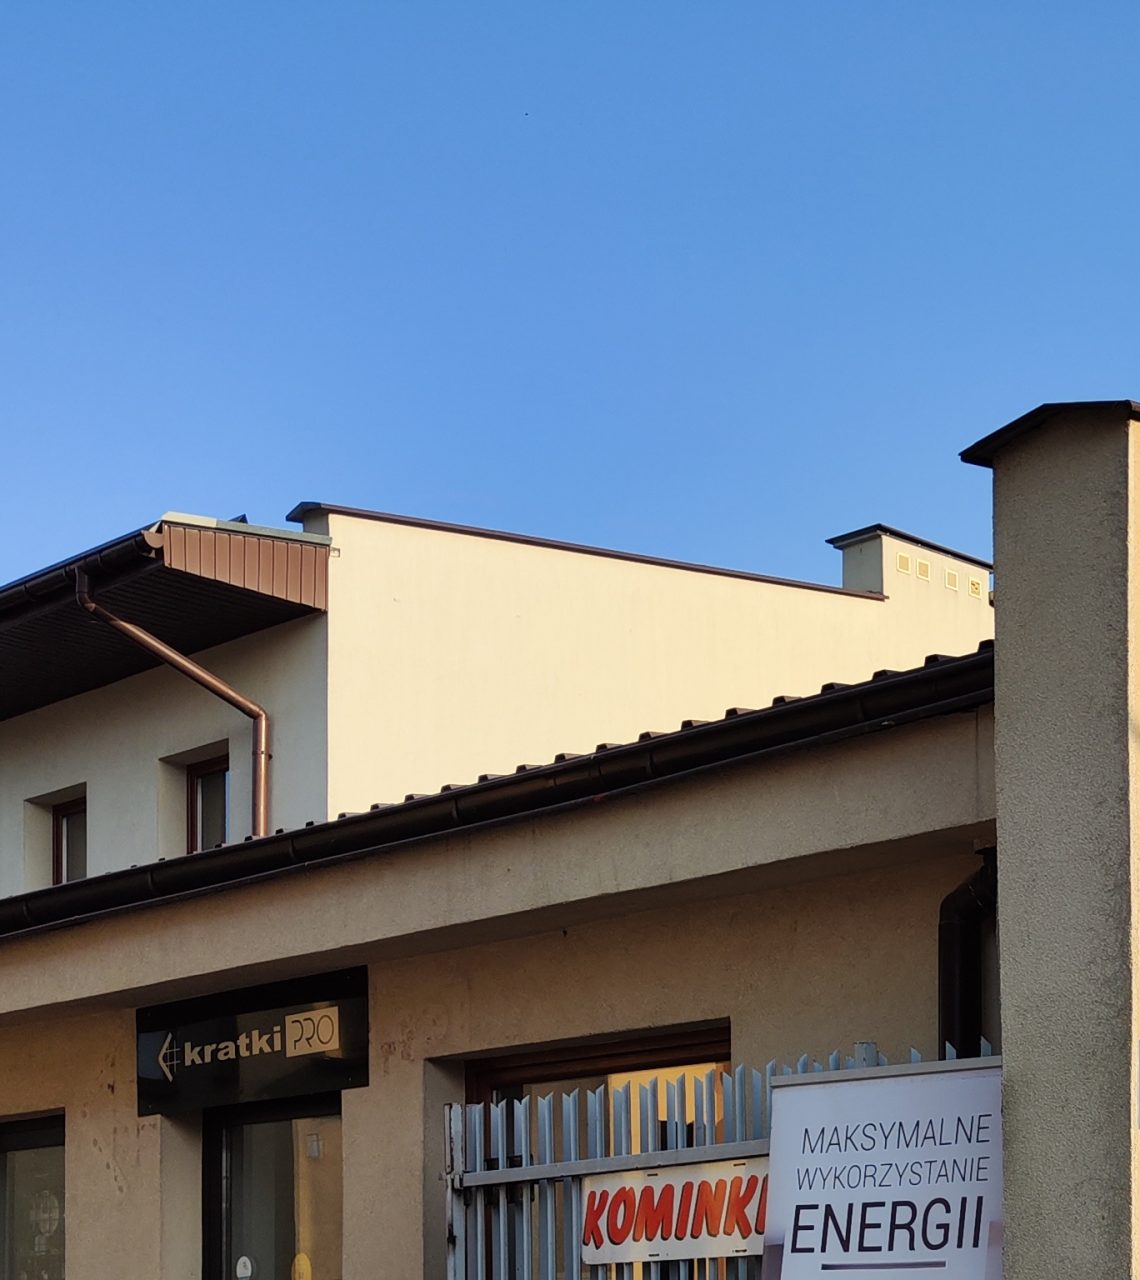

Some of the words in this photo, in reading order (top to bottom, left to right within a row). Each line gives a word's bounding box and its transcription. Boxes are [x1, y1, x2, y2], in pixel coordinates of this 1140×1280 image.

[184, 1026, 281, 1066] kratki
[291, 1014, 334, 1050] PRO
[801, 1114, 992, 1155] MAKSYMALNE
[796, 1156, 990, 1191] WYKORZYSTANIE
[790, 1196, 984, 1254] ENERGII
